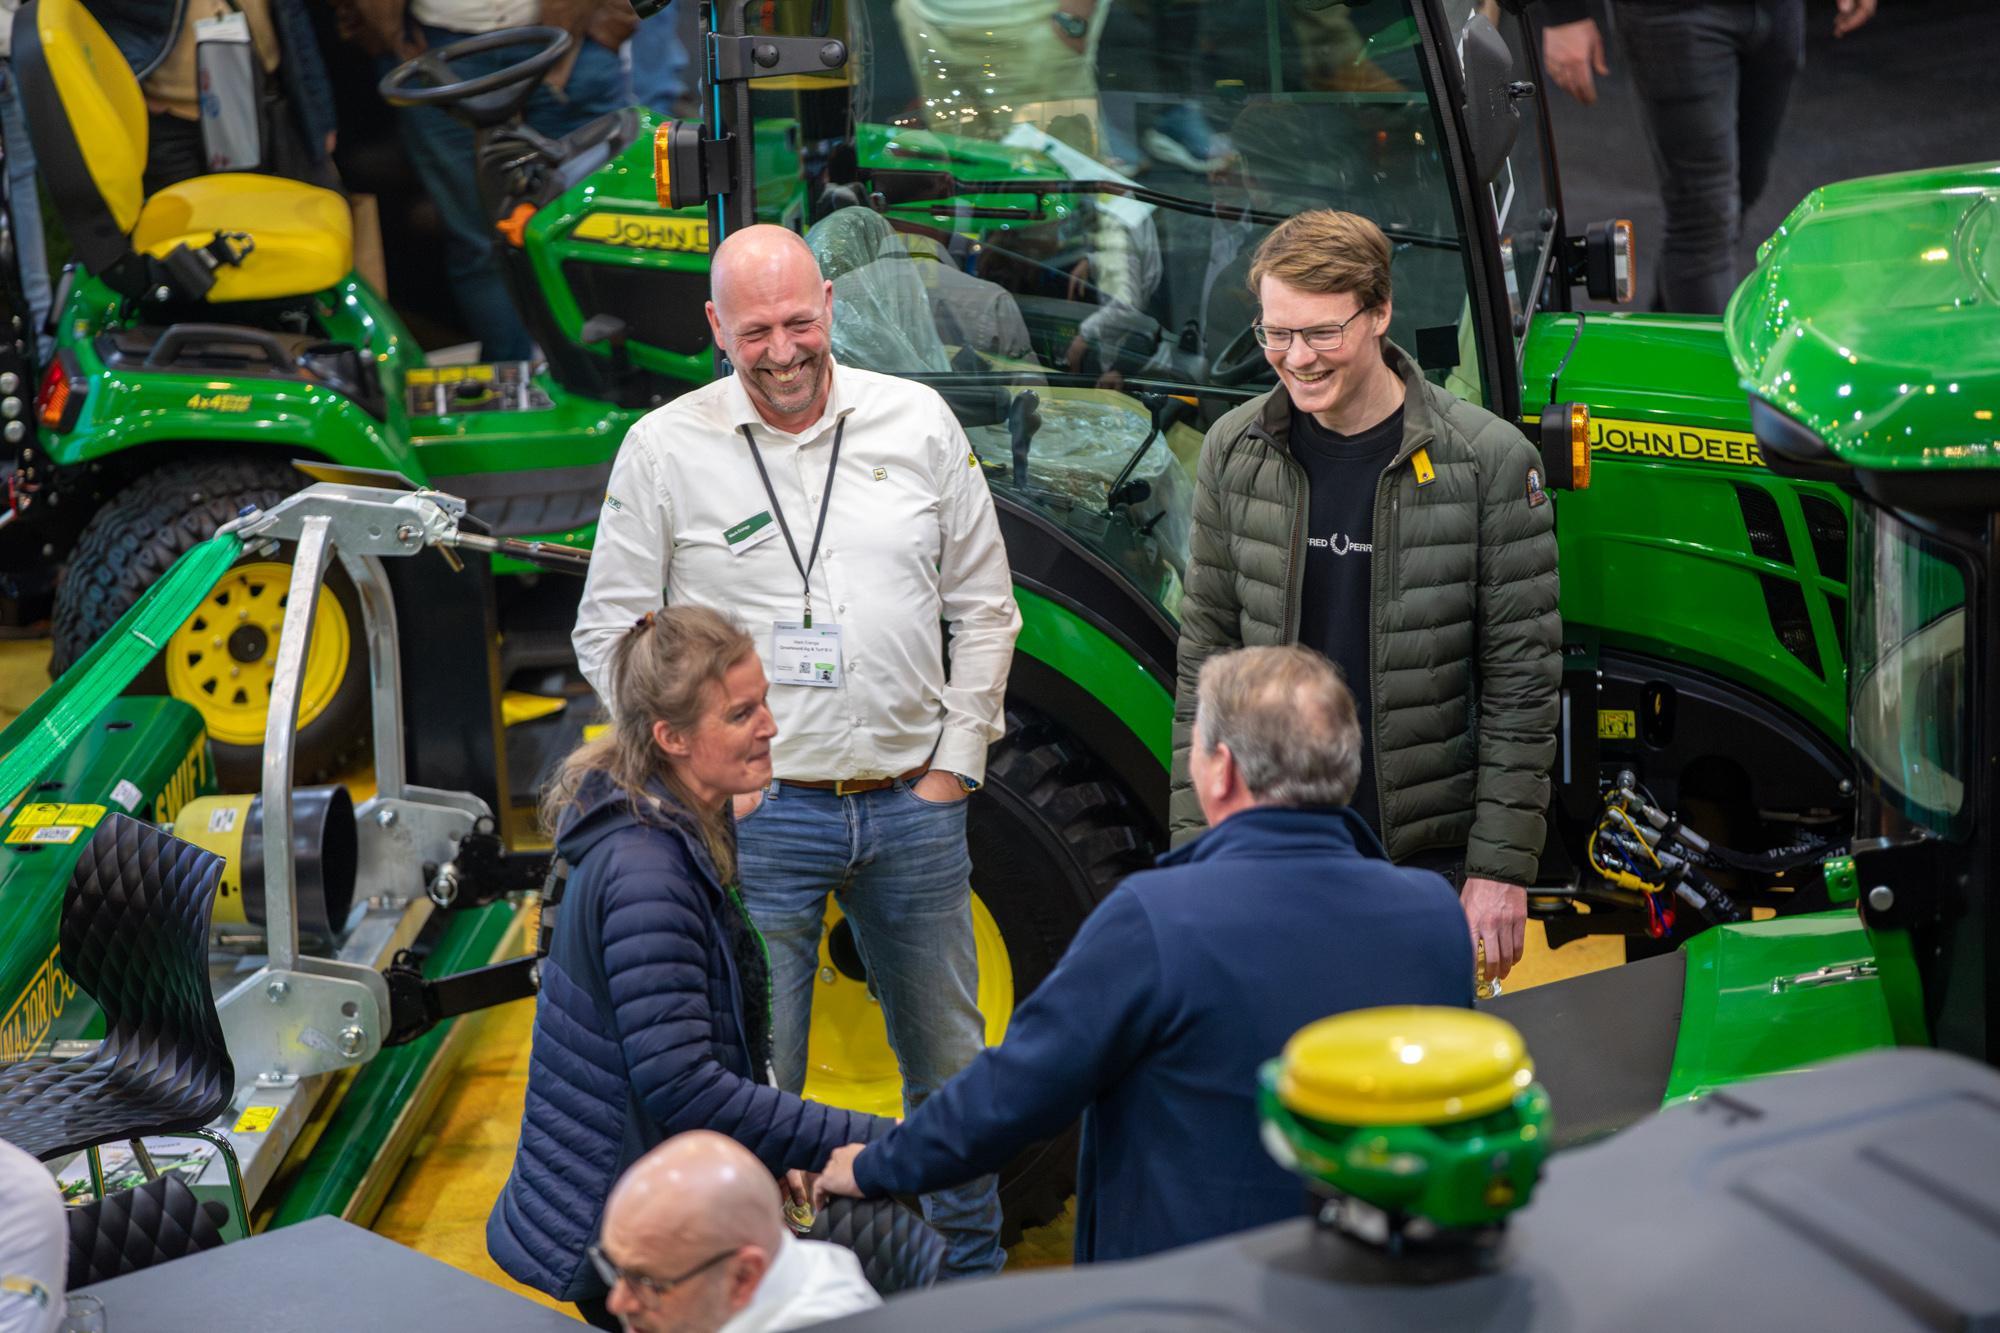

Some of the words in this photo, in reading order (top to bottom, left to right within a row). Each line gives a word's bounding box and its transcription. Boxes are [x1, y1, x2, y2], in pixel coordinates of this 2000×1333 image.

[607, 216, 687, 246] JOHN
[1590, 423, 1674, 454] JOHN
[1679, 432, 1767, 463] DEER
[1349, 541, 1374, 553] PERR
[156, 728, 206, 824] SWIFT
[3, 977, 48, 1063] MAJOR
